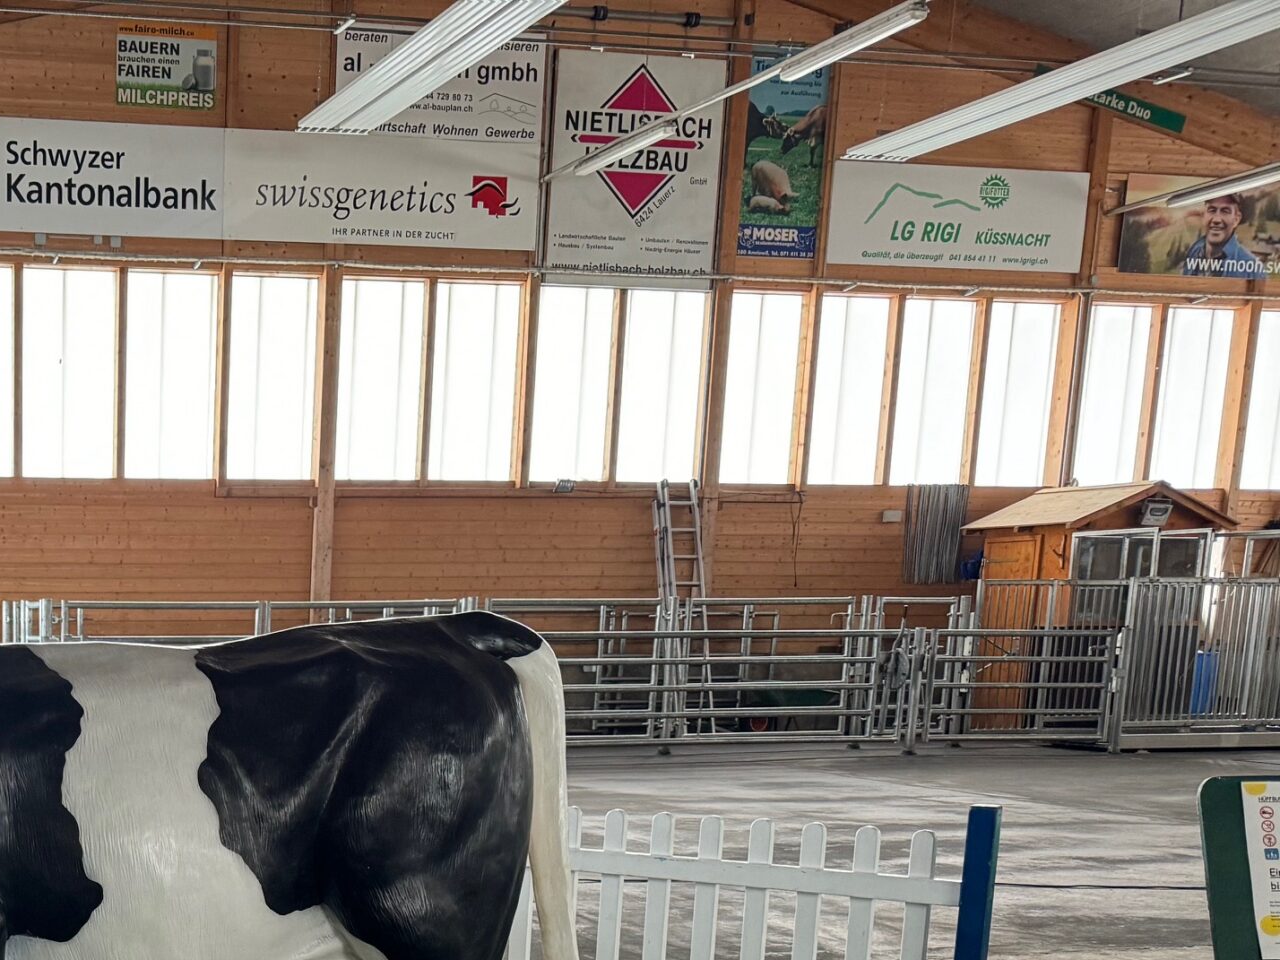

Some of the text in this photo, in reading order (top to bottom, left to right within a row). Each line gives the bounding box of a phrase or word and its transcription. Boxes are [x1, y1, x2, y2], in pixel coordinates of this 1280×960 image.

[344, 31, 389, 43] beraten
[118, 40, 181, 56] BAUERN
[118, 54, 181, 66] brauchen einen
[118, 64, 172, 79] FAIREN
[477, 62, 538, 85] gmbh
[118, 88, 214, 108] MILCHPREIS
[464, 94, 473, 102] 73
[1127, 101, 1151, 120] Duo
[375, 122, 535, 140] irtschaft Wohnen Gewerbe
[6, 140, 126, 175] Schwyzer
[689, 176, 708, 186] GmbH
[6, 172, 217, 212] Kantonalbank
[255, 174, 457, 221] swissgenetics
[634, 206, 654, 228] 6424
[331, 227, 456, 240] IHR PARTNER IN DER ZUCHT
[752, 227, 799, 241] MOSER
[890, 220, 1051, 248] LG RIGI KÜSSNACHT
[861, 250, 892, 260] Qualität,
[893, 251, 905, 259] die
[949, 254, 961, 262] 041
[989, 255, 996, 263] 11
